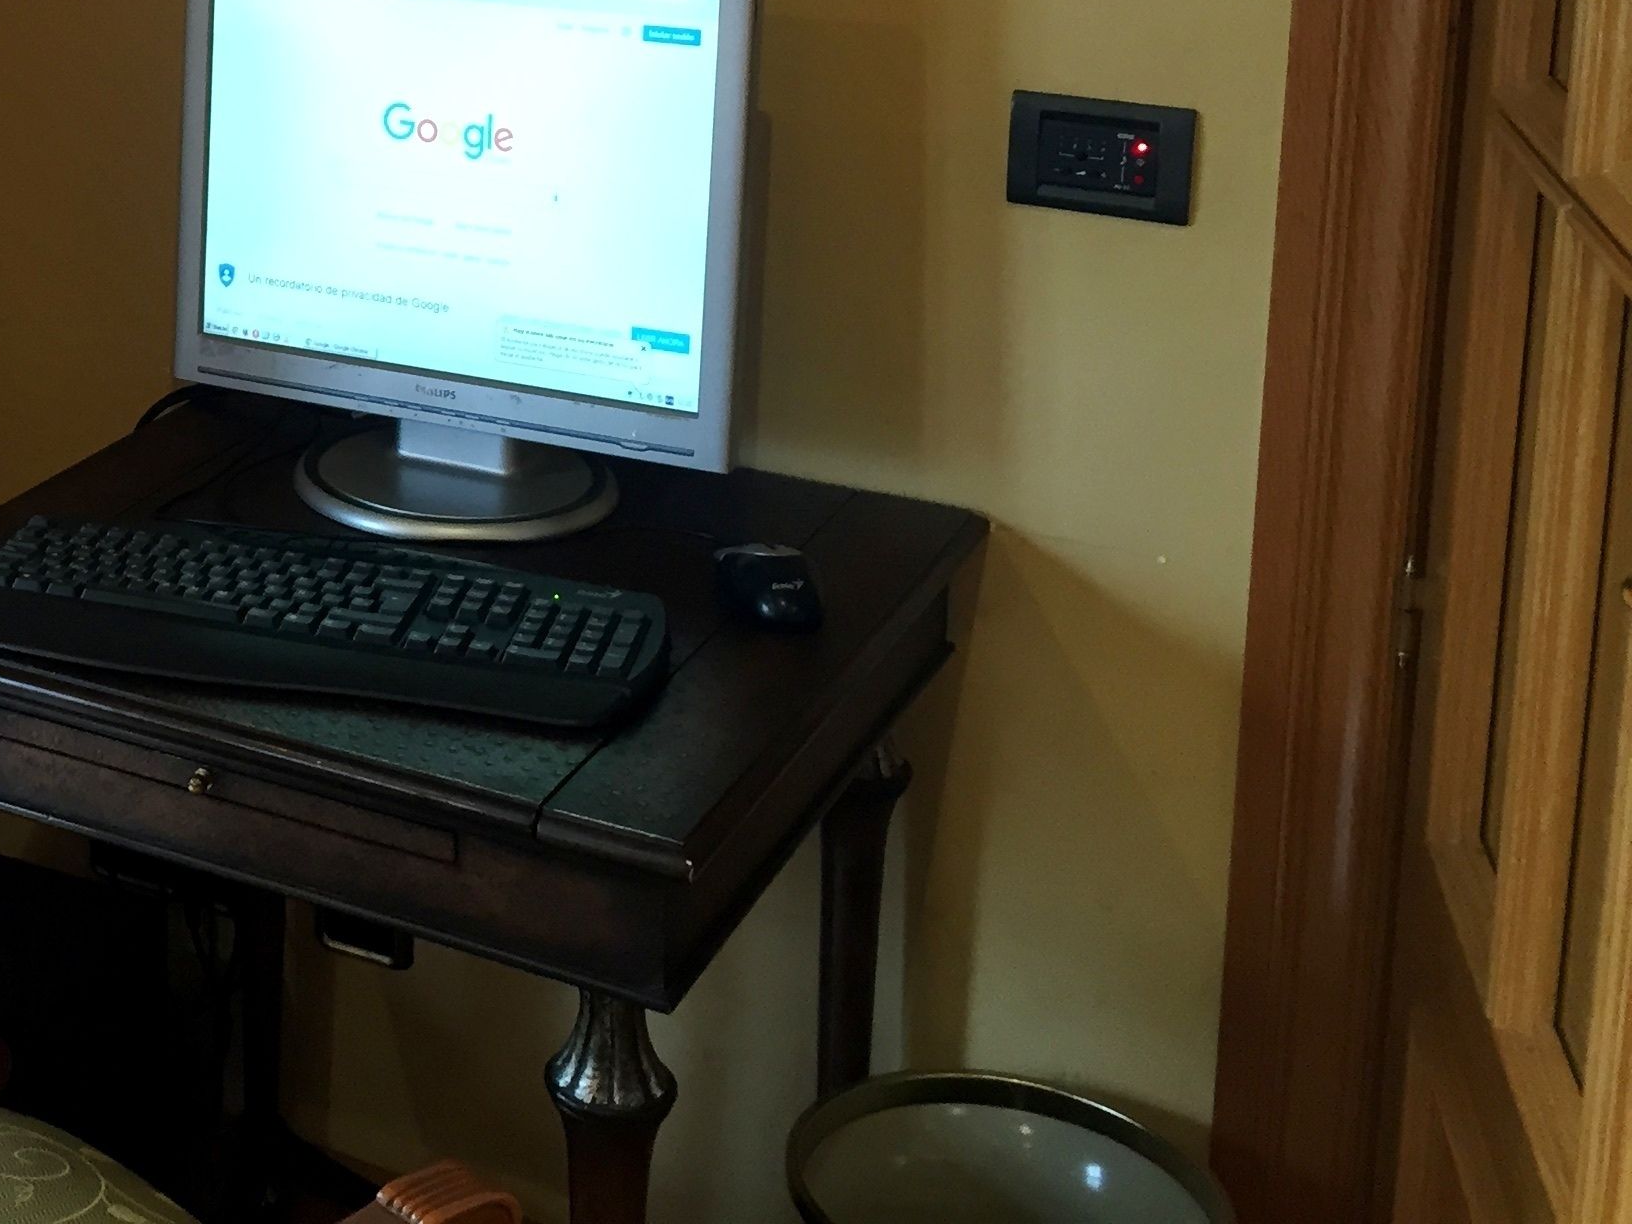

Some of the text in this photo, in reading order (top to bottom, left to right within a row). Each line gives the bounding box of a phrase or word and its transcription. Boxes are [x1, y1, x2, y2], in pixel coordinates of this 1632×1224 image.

[383, 102, 514, 160] Google
[248, 272, 450, 314] Un recordatorio de privacidad de Google
